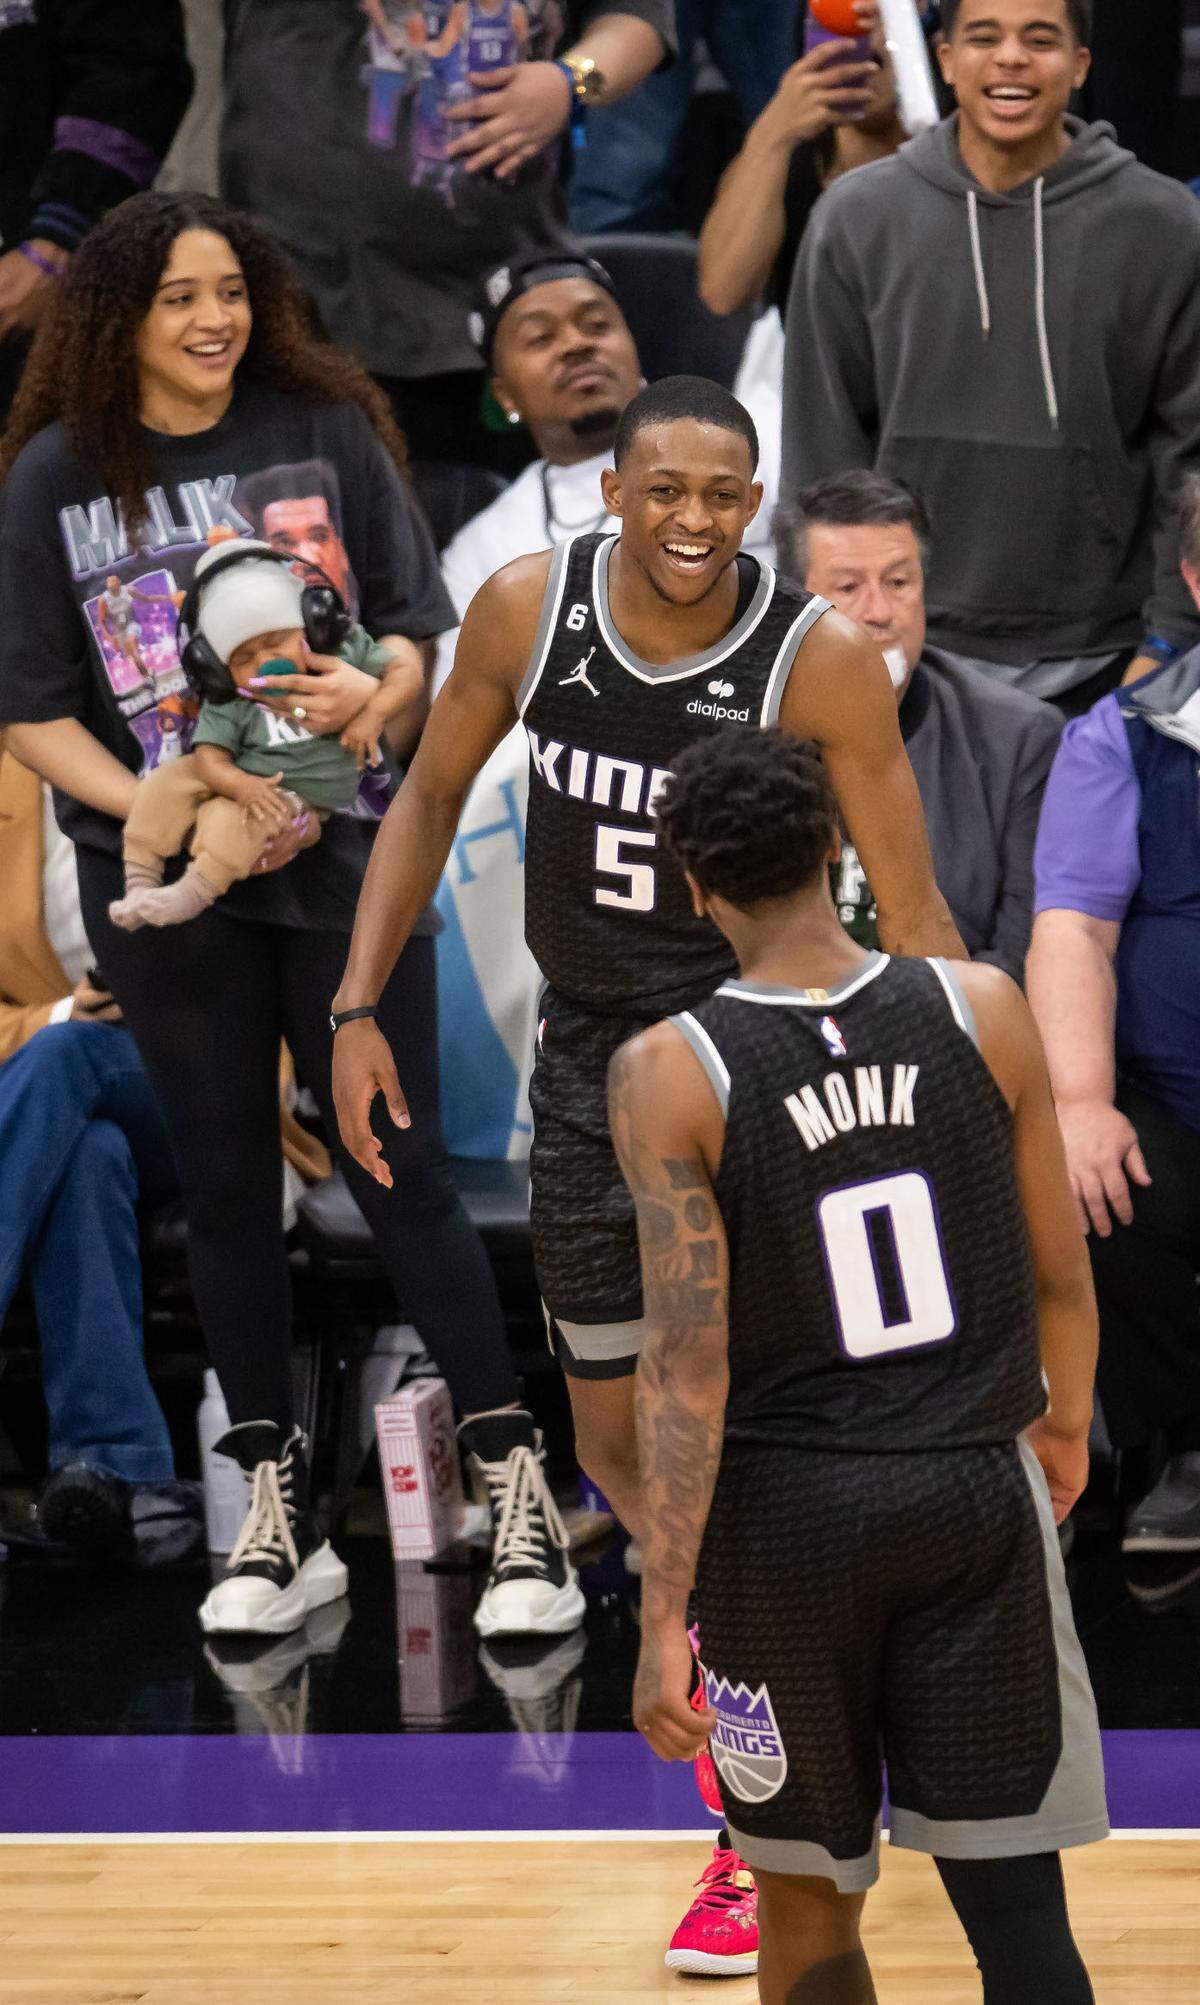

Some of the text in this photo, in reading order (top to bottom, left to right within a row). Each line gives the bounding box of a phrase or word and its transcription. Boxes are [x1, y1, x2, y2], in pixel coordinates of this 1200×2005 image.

[60, 473, 256, 575] MLIK
[566, 603, 589, 631] 6
[686, 700, 750, 722] dialpad
[595, 825, 656, 912] 5
[783, 1063, 920, 1152] MONK
[817, 1169, 958, 1361] 0
